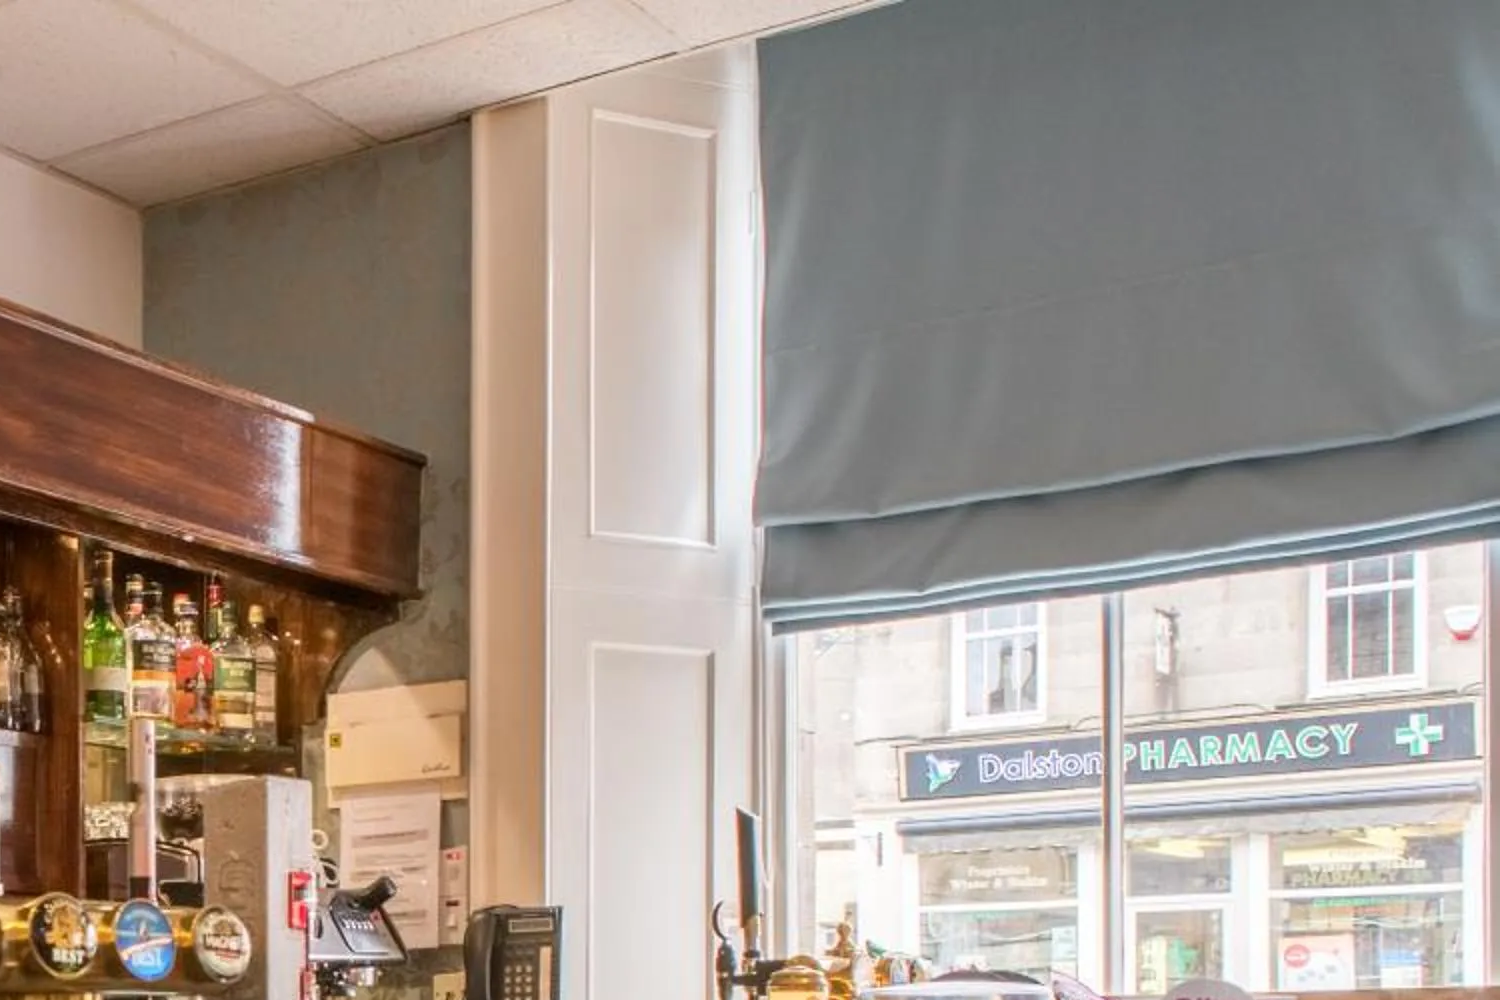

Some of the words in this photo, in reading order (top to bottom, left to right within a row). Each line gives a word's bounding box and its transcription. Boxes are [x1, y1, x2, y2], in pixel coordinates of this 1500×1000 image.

[979, 749, 1105, 784] Dalston
[1122, 723, 1359, 772] PHARMACY
[51, 948, 85, 963] BEST
